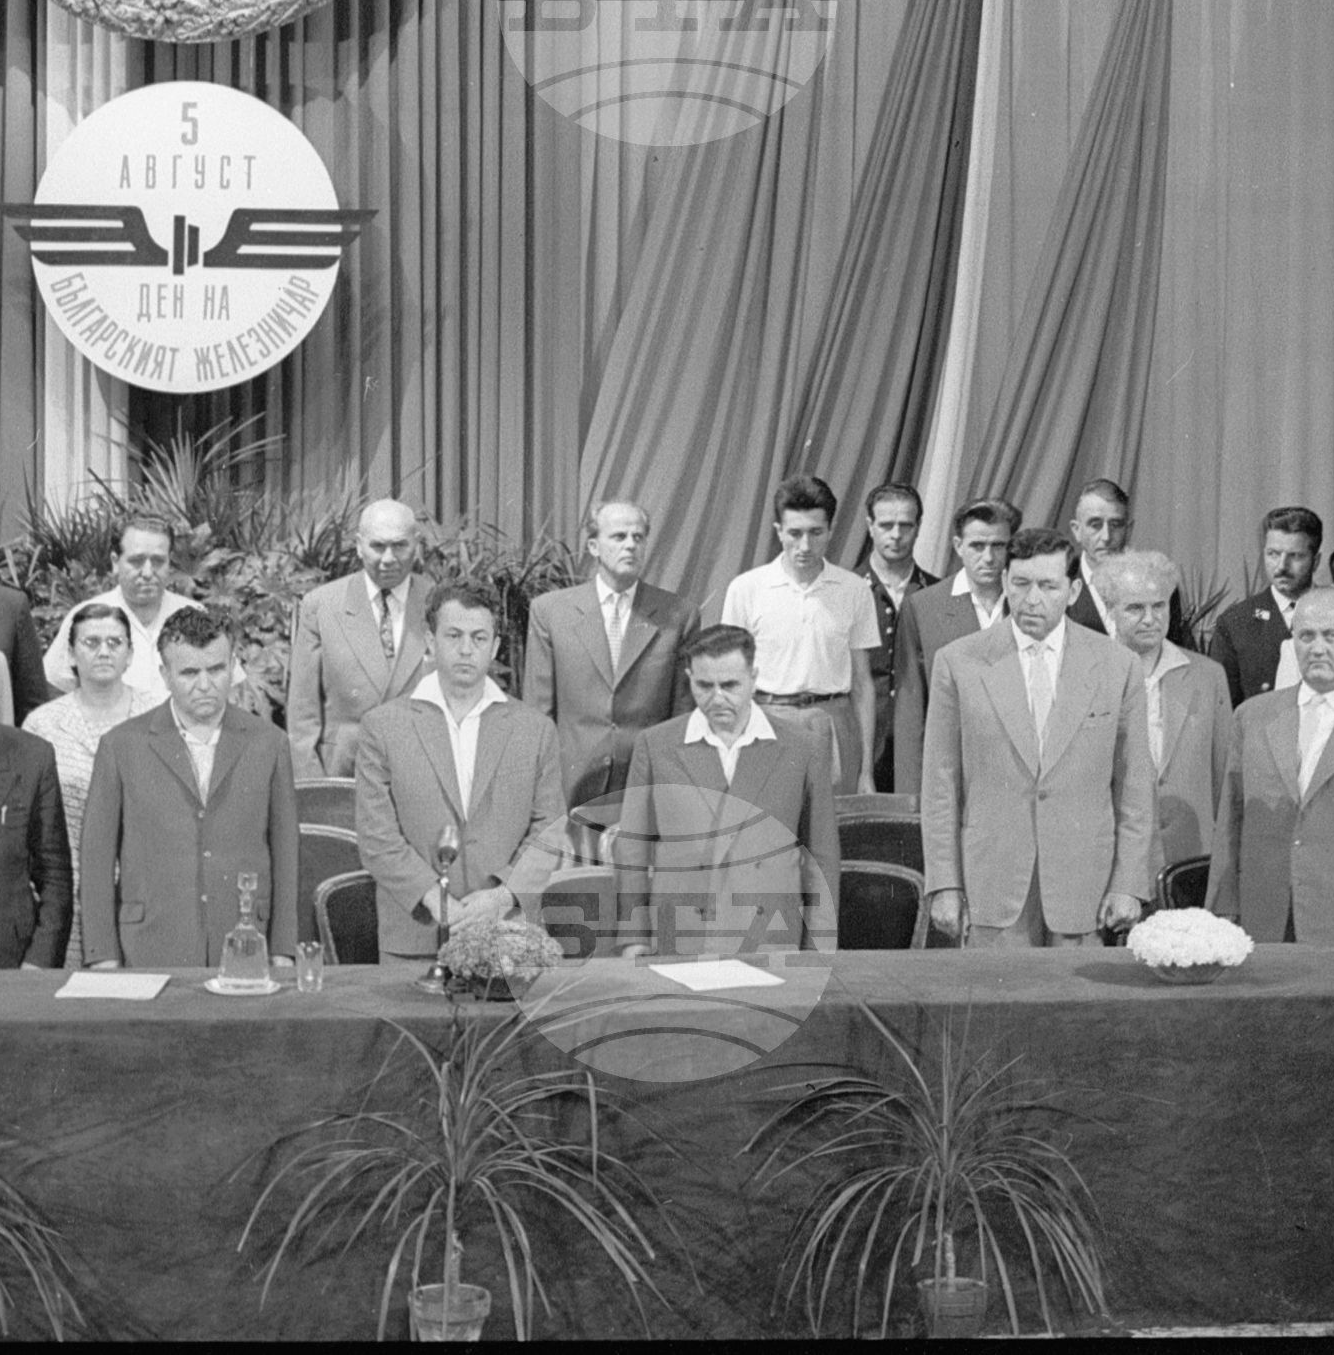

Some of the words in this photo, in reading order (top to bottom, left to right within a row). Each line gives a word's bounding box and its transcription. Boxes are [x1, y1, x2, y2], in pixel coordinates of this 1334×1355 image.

[180, 102, 199, 146] 5
[119, 154, 257, 190] АВГУСТ
[136, 283, 185, 323] ДЕН
[202, 284, 230, 321] НА
[49, 271, 180, 382] БЪЛГАРСКИЯТ
[193, 274, 320, 383] ЖЕЛЕЗНИЧАР
